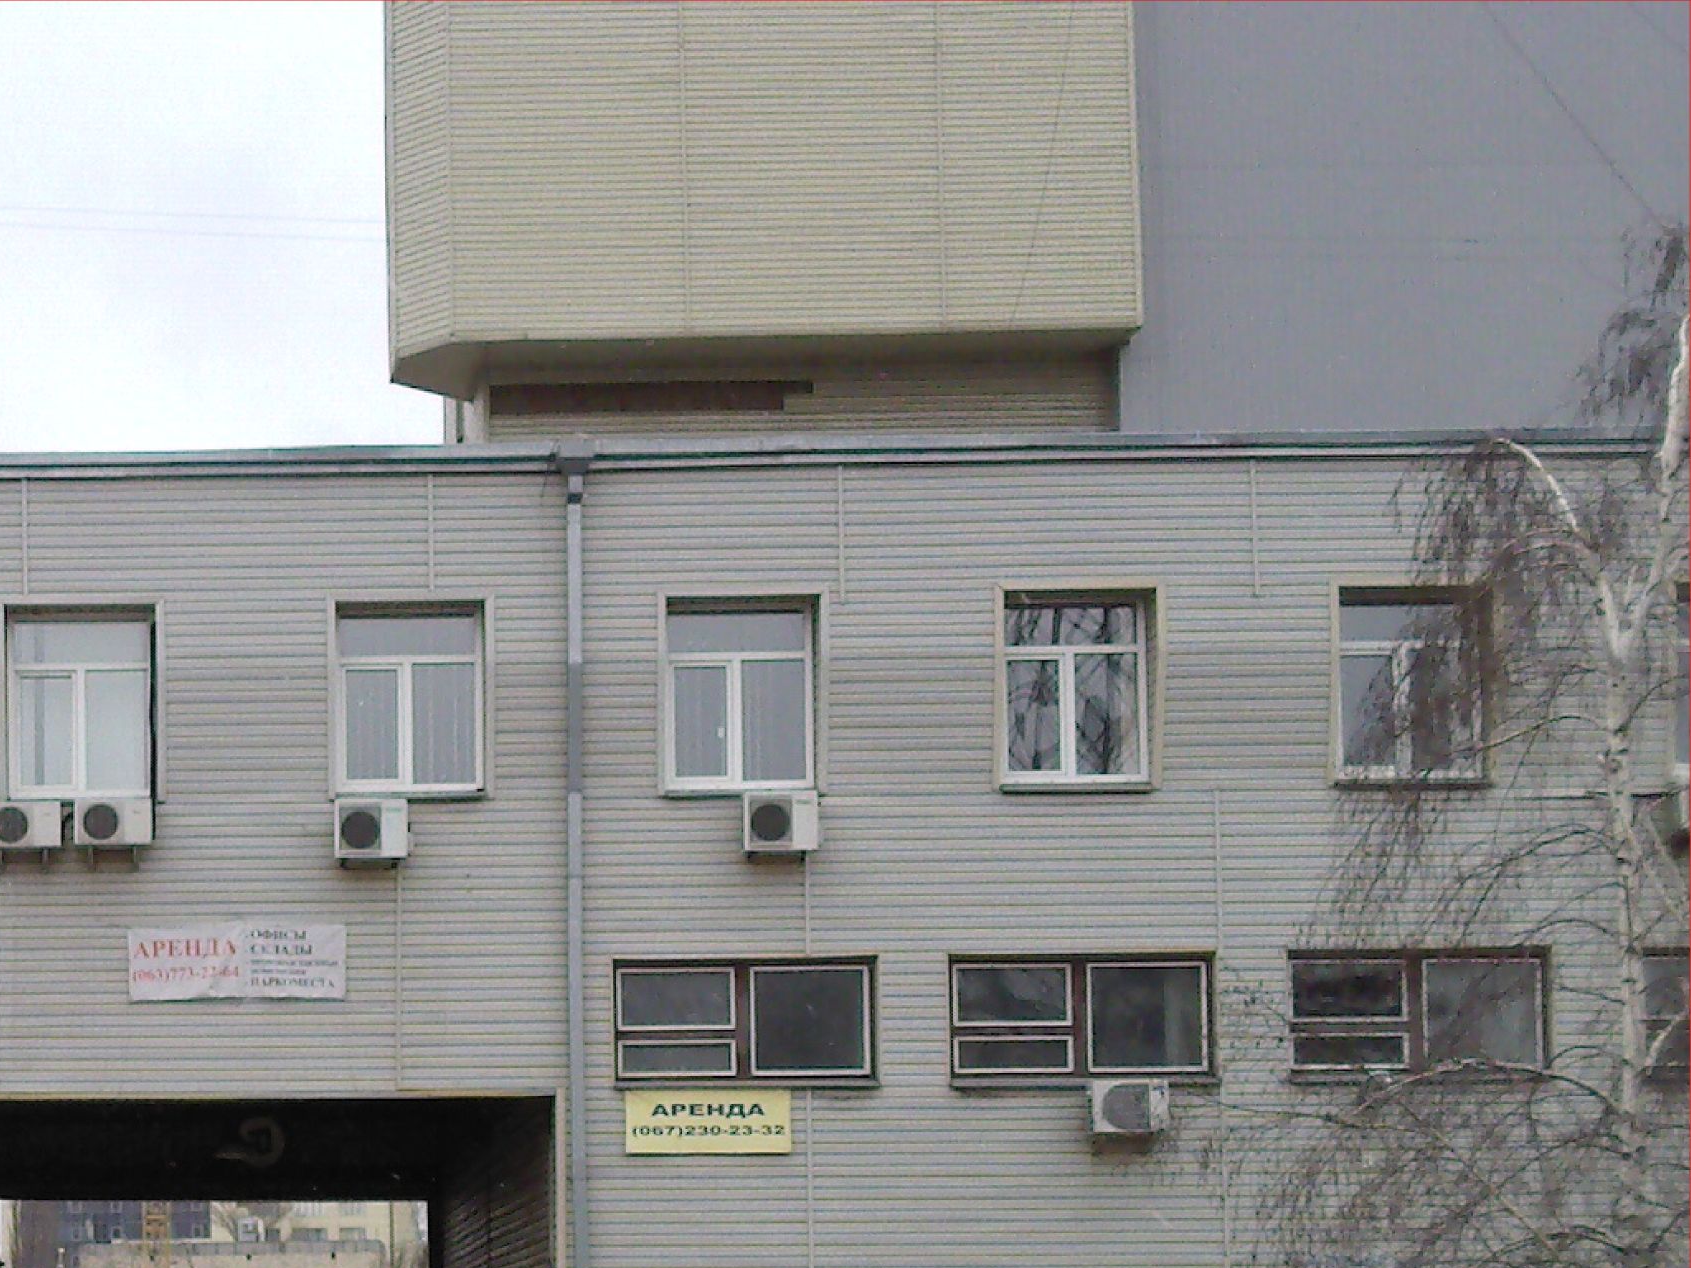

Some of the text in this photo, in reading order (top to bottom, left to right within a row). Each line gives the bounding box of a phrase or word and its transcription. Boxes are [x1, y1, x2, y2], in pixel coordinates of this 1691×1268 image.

[133, 937, 236, 959] АРЕНДА
[651, 1103, 765, 1118] АРЕНДА
[631, 1125, 786, 1138] (067)230-23-32
